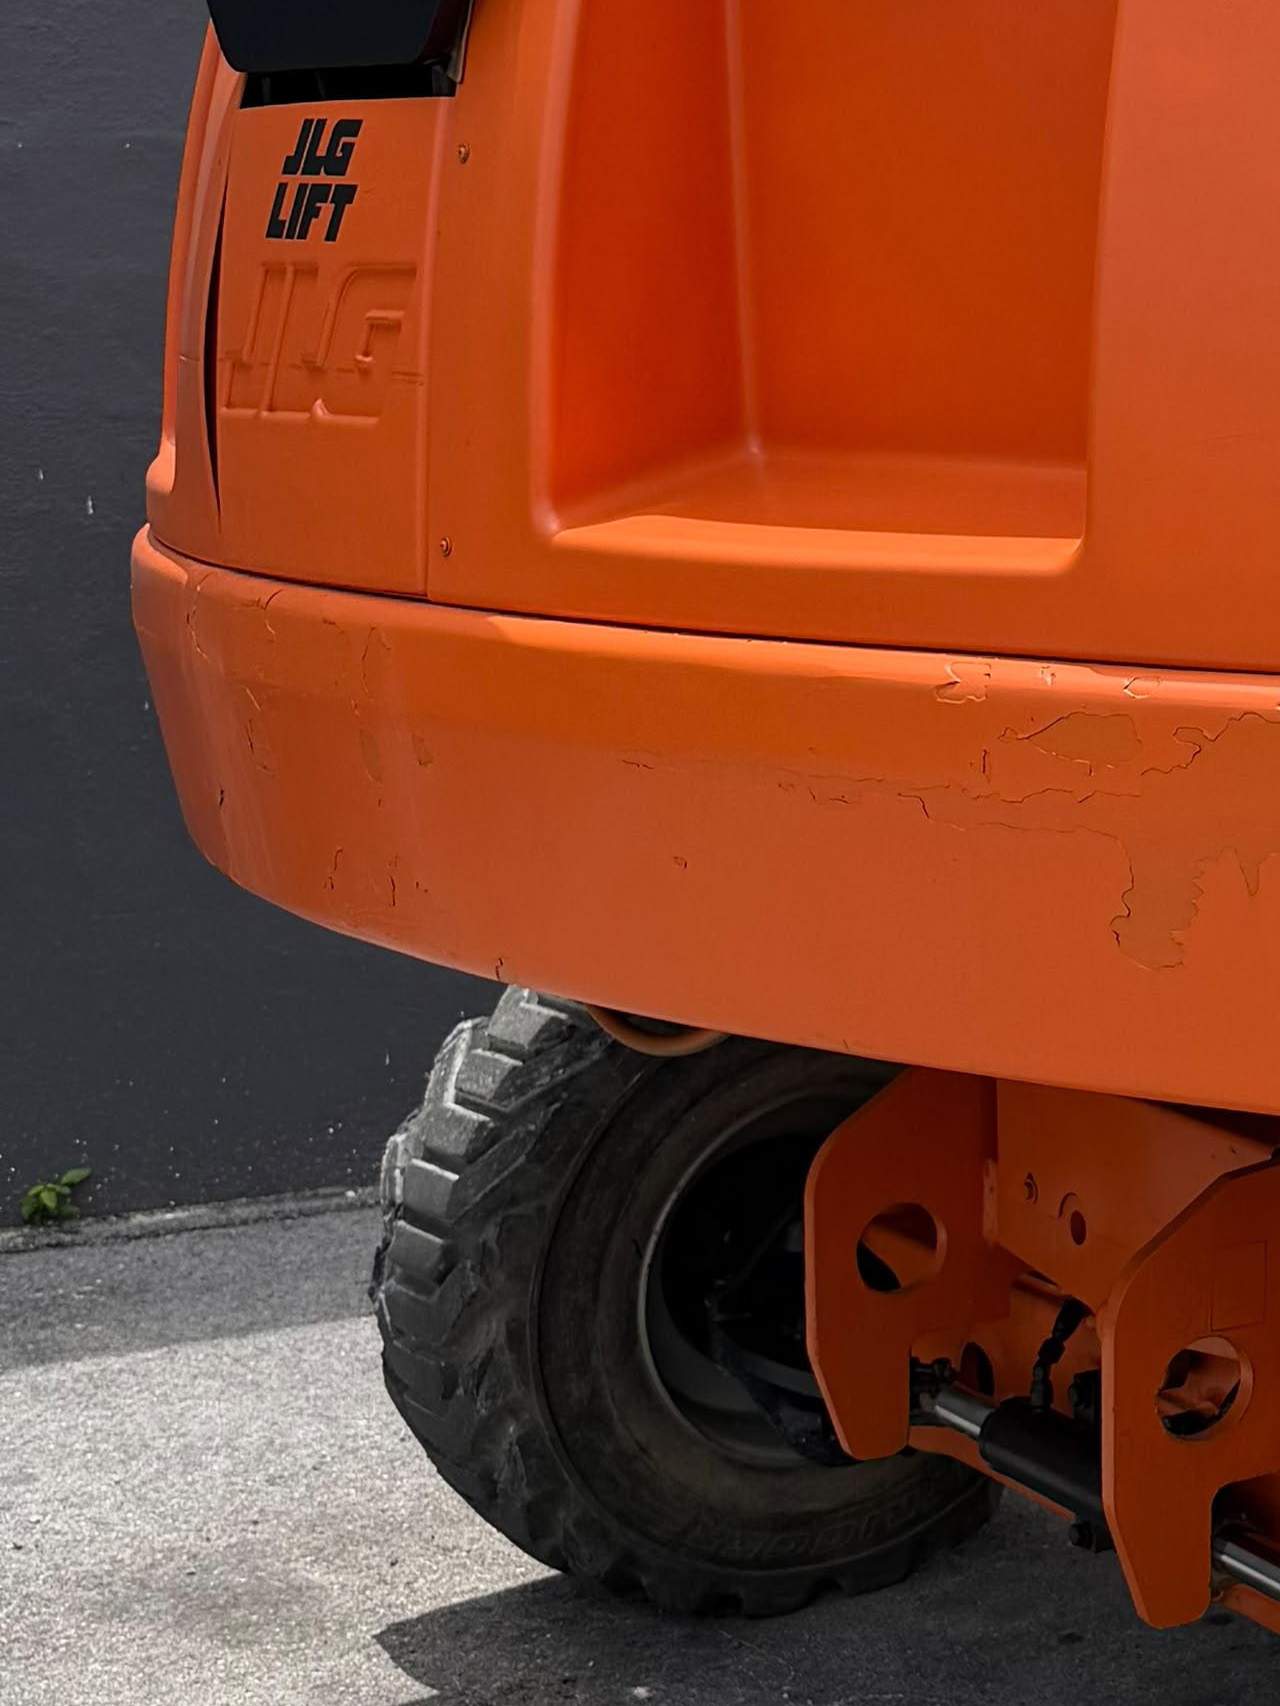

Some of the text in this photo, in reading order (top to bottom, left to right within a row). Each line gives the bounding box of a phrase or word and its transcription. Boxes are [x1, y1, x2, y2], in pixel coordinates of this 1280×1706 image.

[281, 118, 363, 177] JLG
[314, 91, 463, 177] JLG
[265, 182, 359, 243] LIFT
